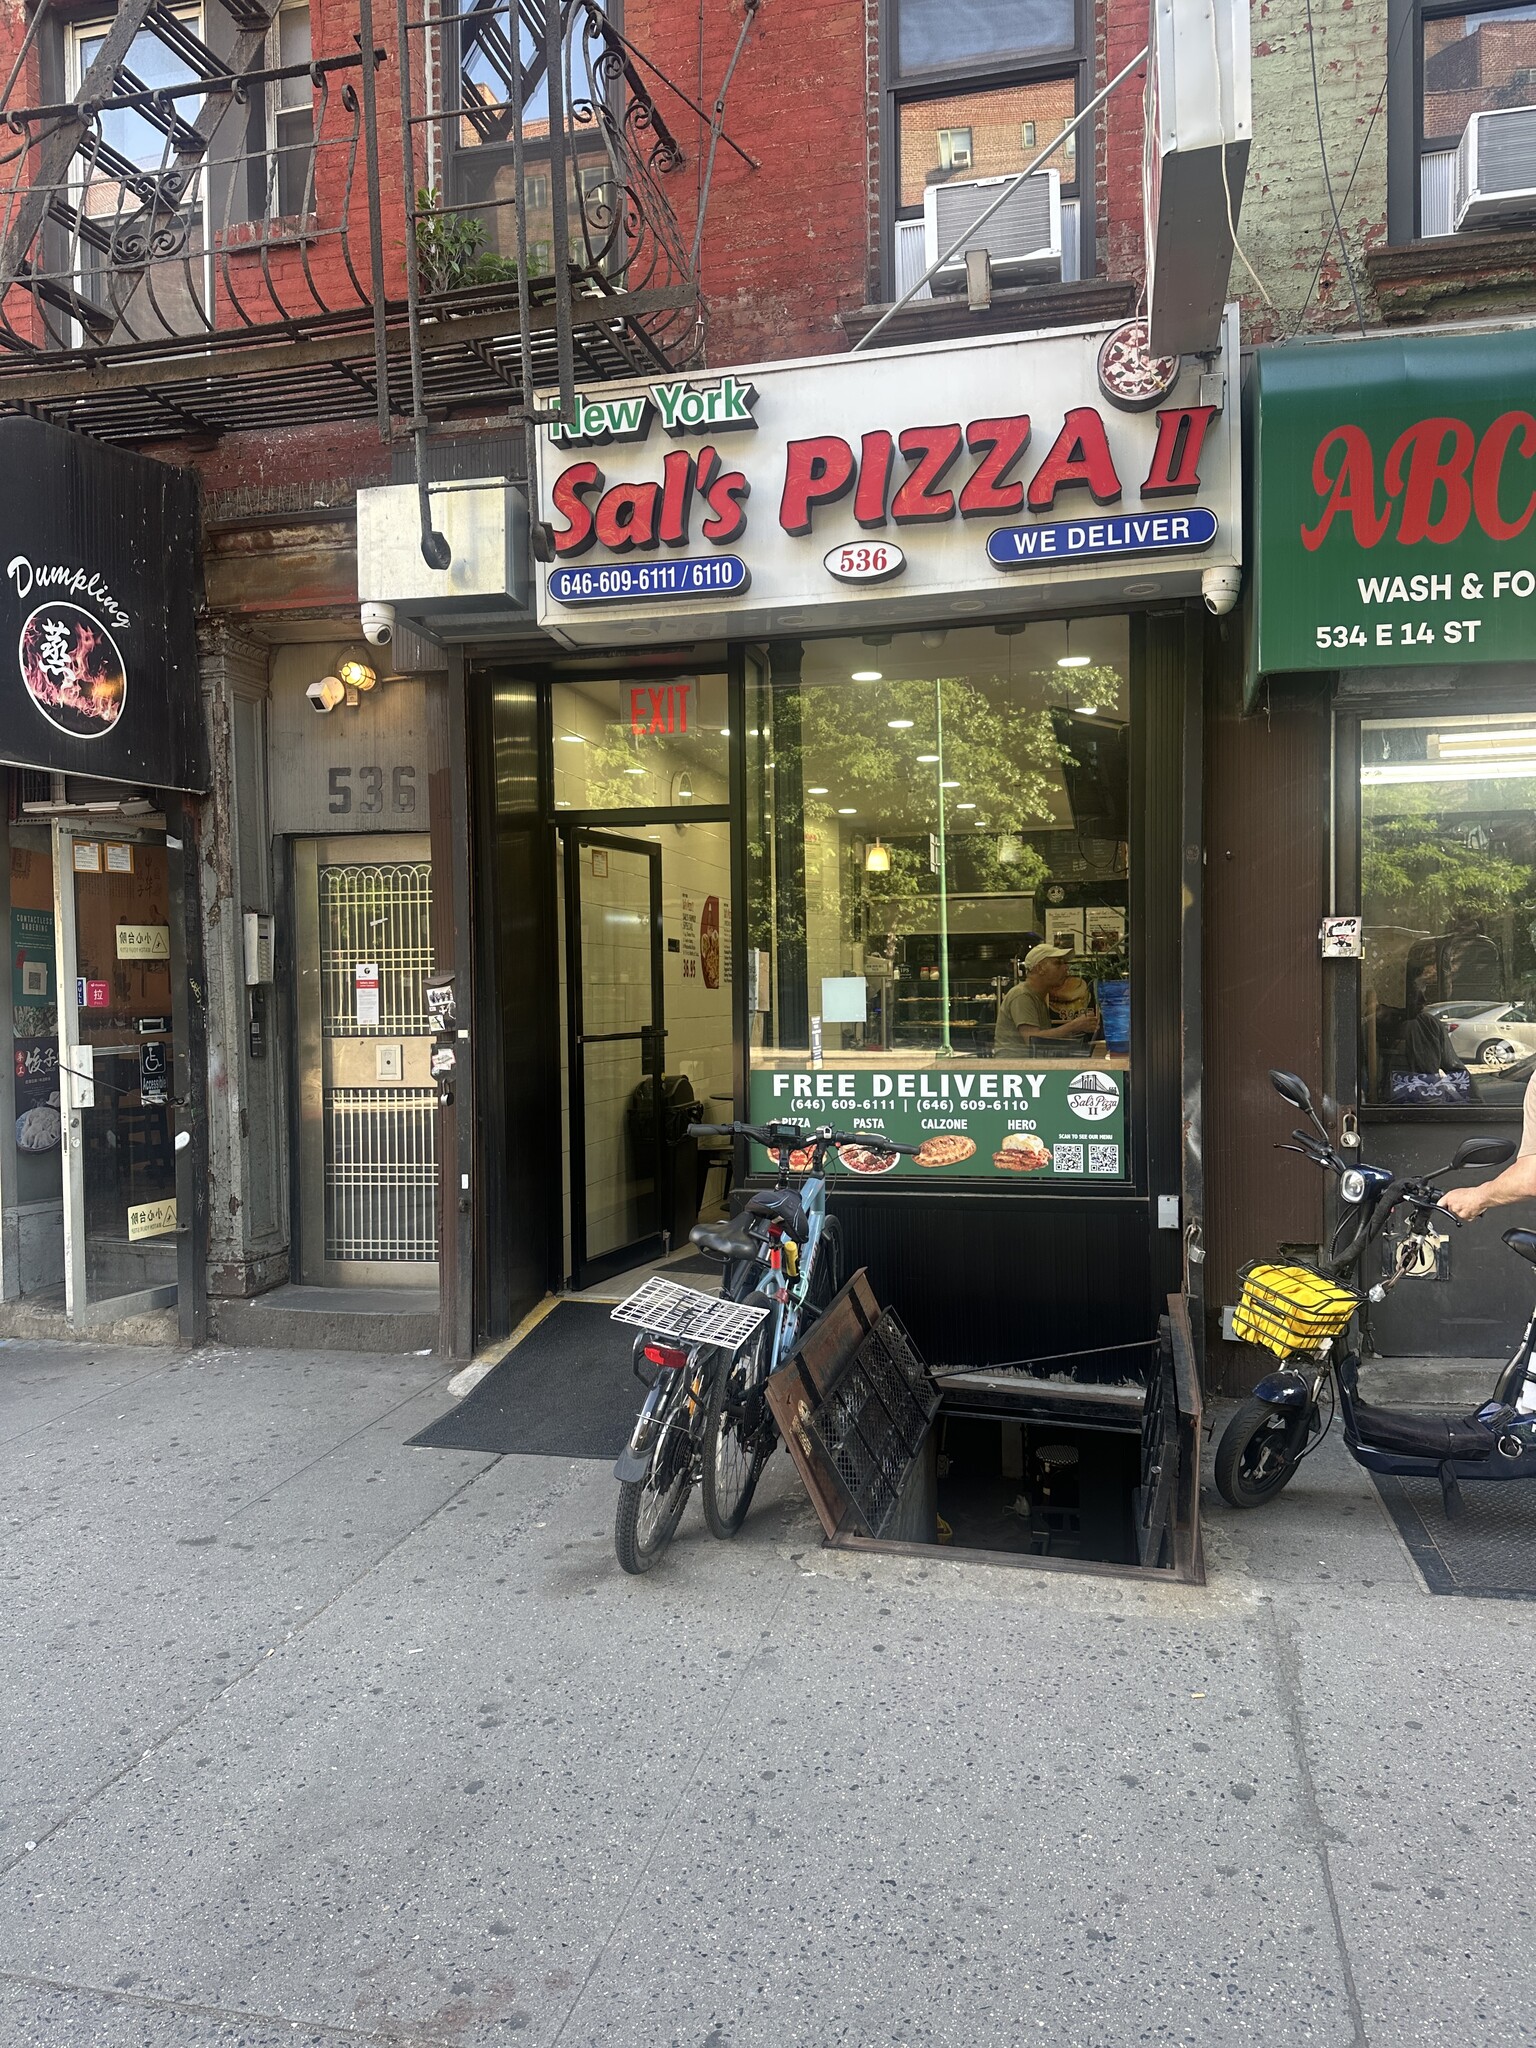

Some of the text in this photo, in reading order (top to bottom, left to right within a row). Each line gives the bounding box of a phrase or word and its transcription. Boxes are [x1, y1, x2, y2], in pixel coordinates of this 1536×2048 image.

[551, 377, 748, 439] New York
[780, 405, 1216, 531] PIZZA II
[1301, 410, 1536, 551] ABC
[553, 446, 746, 551] Sal's
[1014, 518, 1190, 555] WE DELIVER
[839, 548, 887, 572] 536
[560, 565, 677, 597] 646-609-6111
[693, 561, 732, 586] 6110
[1358, 570, 1535, 604] WASH & FO
[7, 555, 131, 629] Dumpling
[1316, 620, 1481, 649] 534 E 14 ST
[630, 685, 691, 736] EXIT
[328, 766, 416, 814] 536
[16, 914, 53, 926] CONTACTLESS
[21, 923, 48, 933] ORDERING
[94, 989, 103, 1000] 拉
[143, 1076, 166, 1090] Accessible
[773, 1074, 1047, 1098] FREE DELIVERY
[791, 1099, 825, 1112] (646)
[832, 1099, 895, 1110] 609-6111
[917, 1099, 954, 1112] (646)
[960, 1100, 1028, 1111] 609-6110
[1070, 1095, 1117, 1111] Sal's Pizza
[1088, 1107, 1099, 1116] II
[781, 1117, 811, 1128] PIZZA
[854, 1117, 885, 1129] PASTA
[921, 1118, 968, 1130] CALZONE
[1007, 1119, 1037, 1131] HERO
